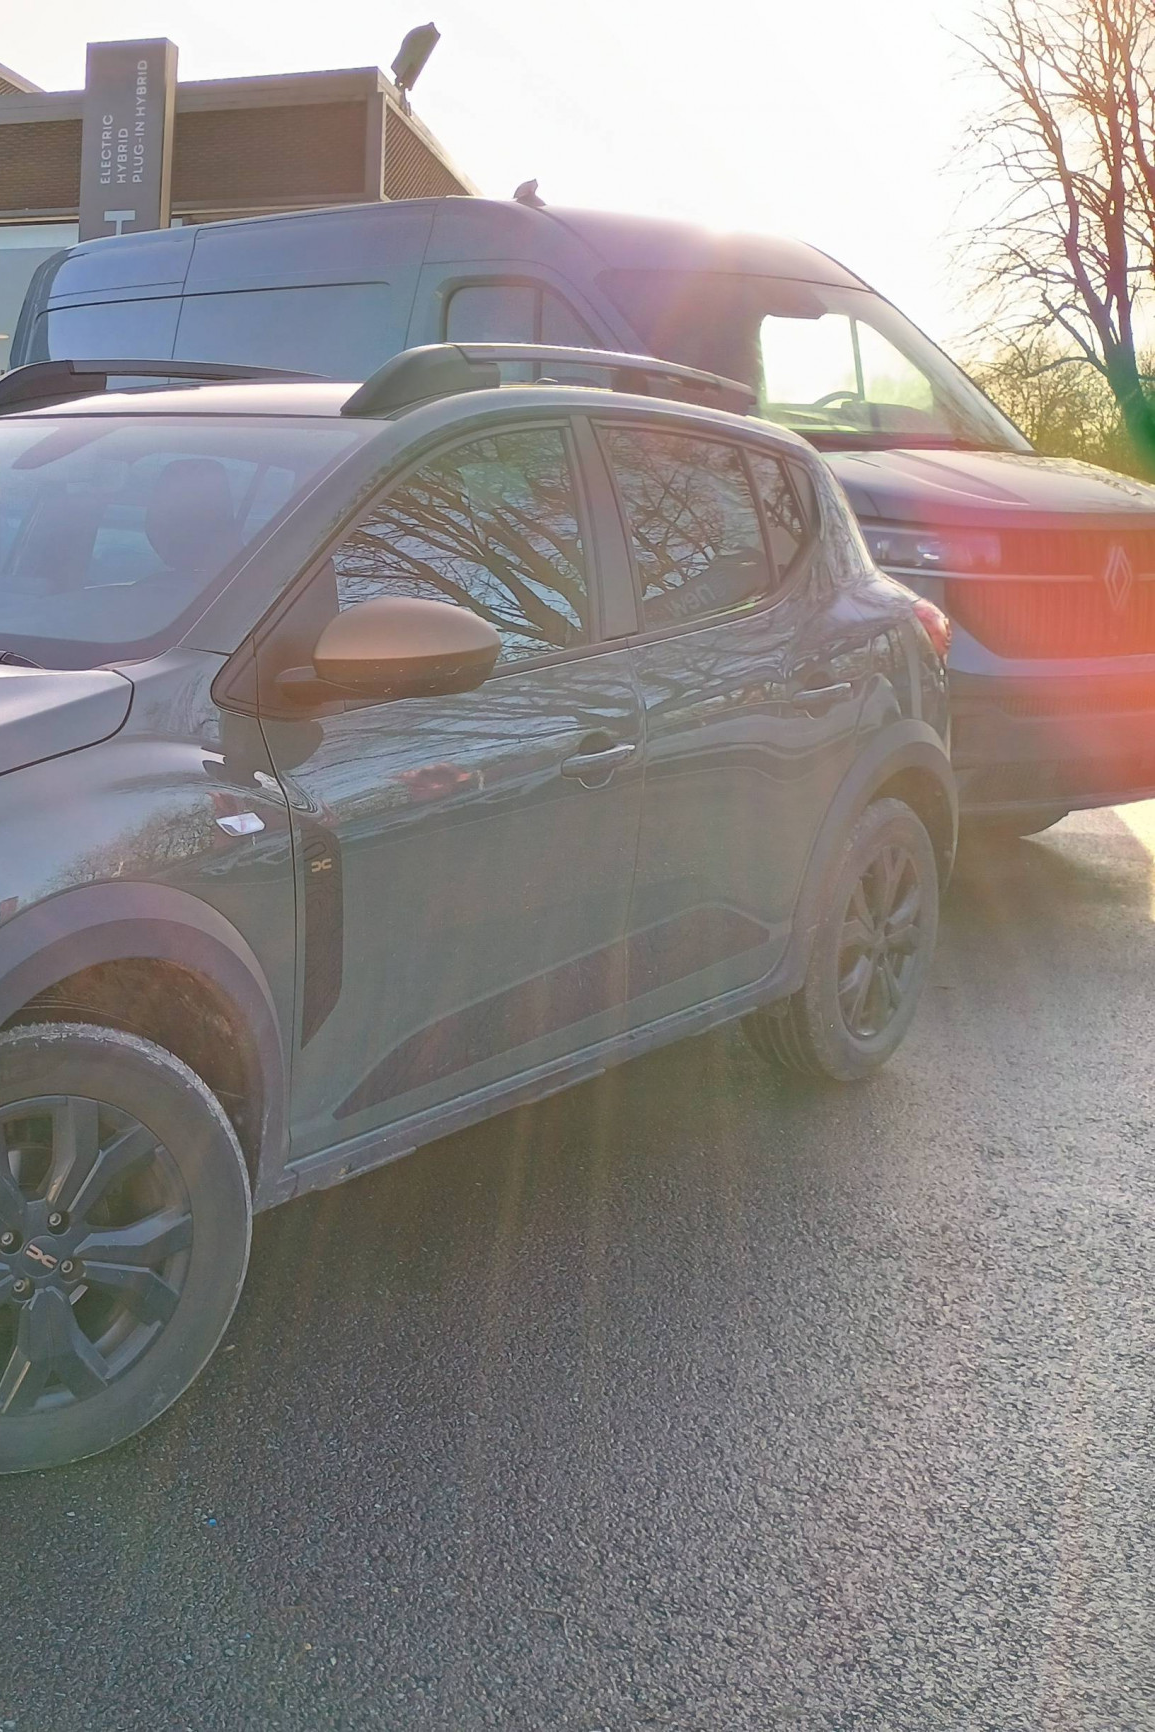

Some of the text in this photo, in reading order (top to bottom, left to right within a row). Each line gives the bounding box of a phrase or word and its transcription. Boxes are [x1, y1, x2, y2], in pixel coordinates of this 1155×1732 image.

[100, 114, 114, 184] ELECTRIC
[116, 128, 129, 184] HYBRID
[132, 60, 148, 183] PLUG-IN HYBRID
